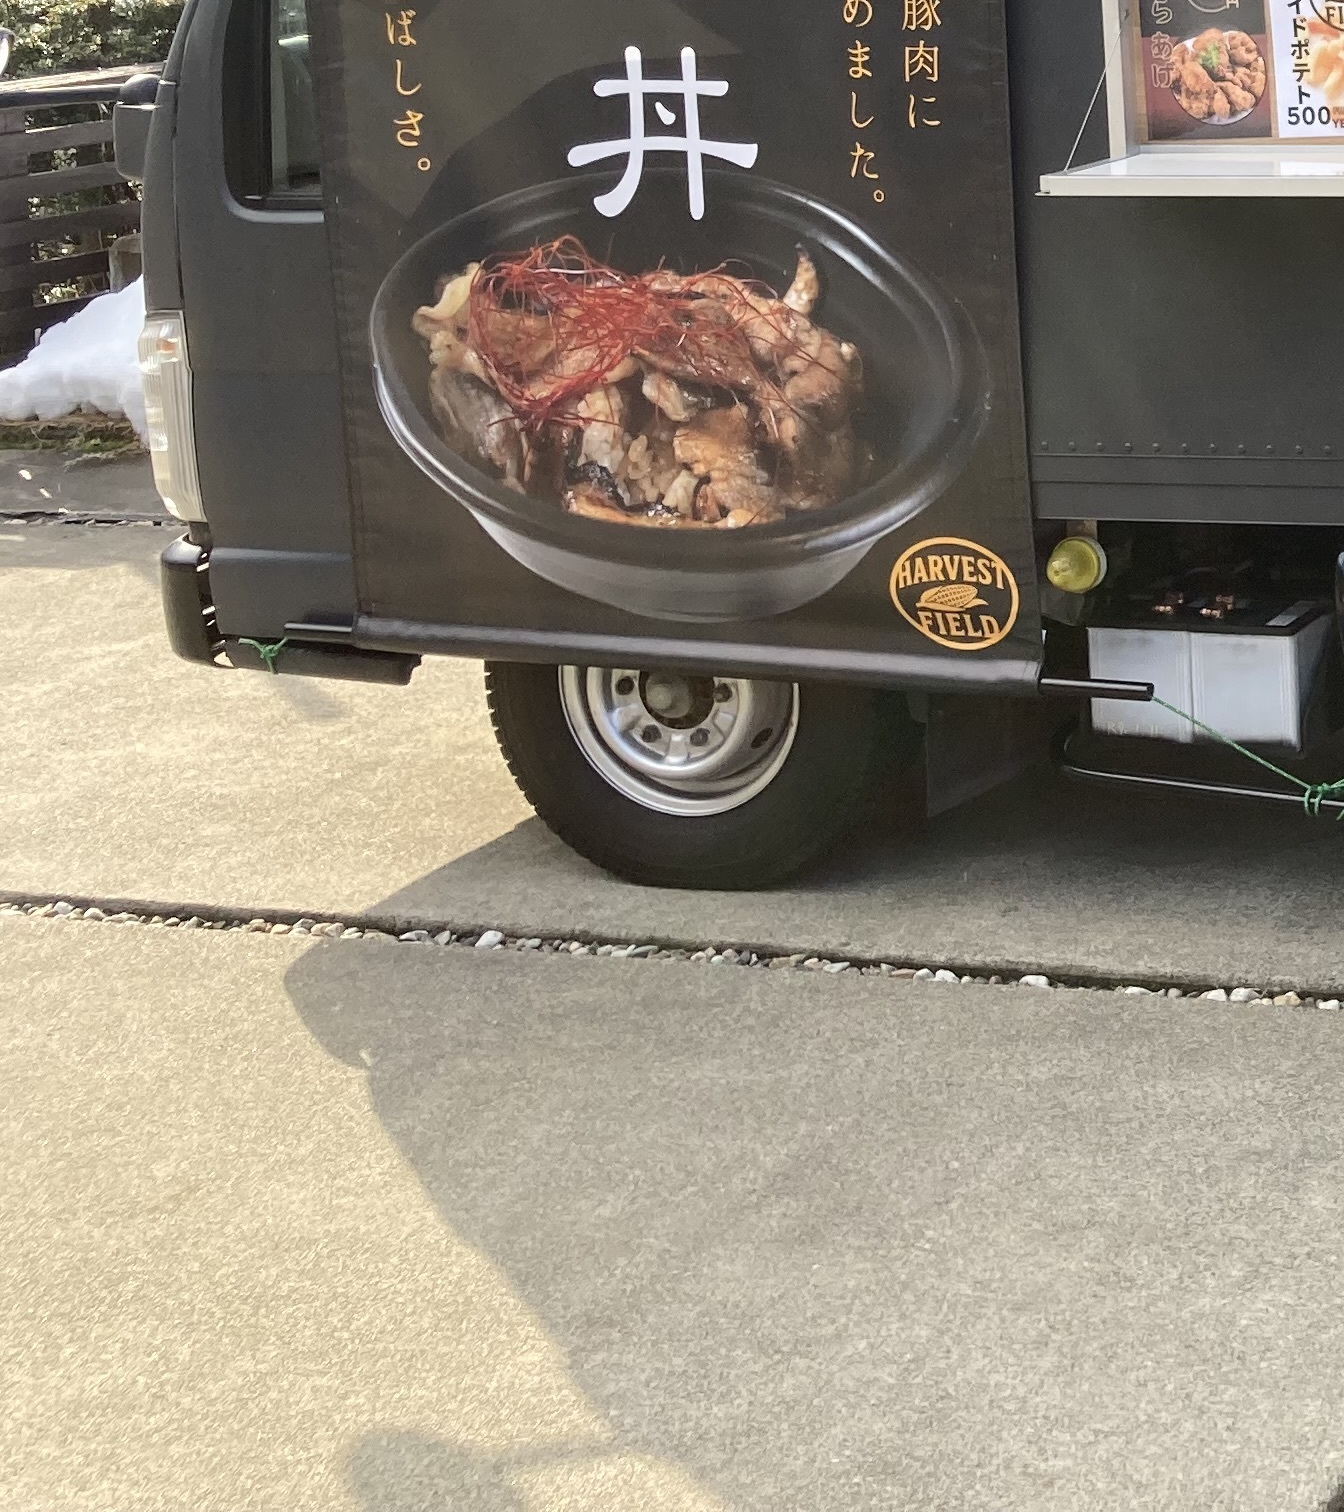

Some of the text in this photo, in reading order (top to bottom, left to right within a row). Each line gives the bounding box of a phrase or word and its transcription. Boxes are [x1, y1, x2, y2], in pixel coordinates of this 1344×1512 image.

[1287, 106, 1332, 126] 500
[897, 555, 1005, 590] HARVEST
[917, 610, 999, 639] FIELD
